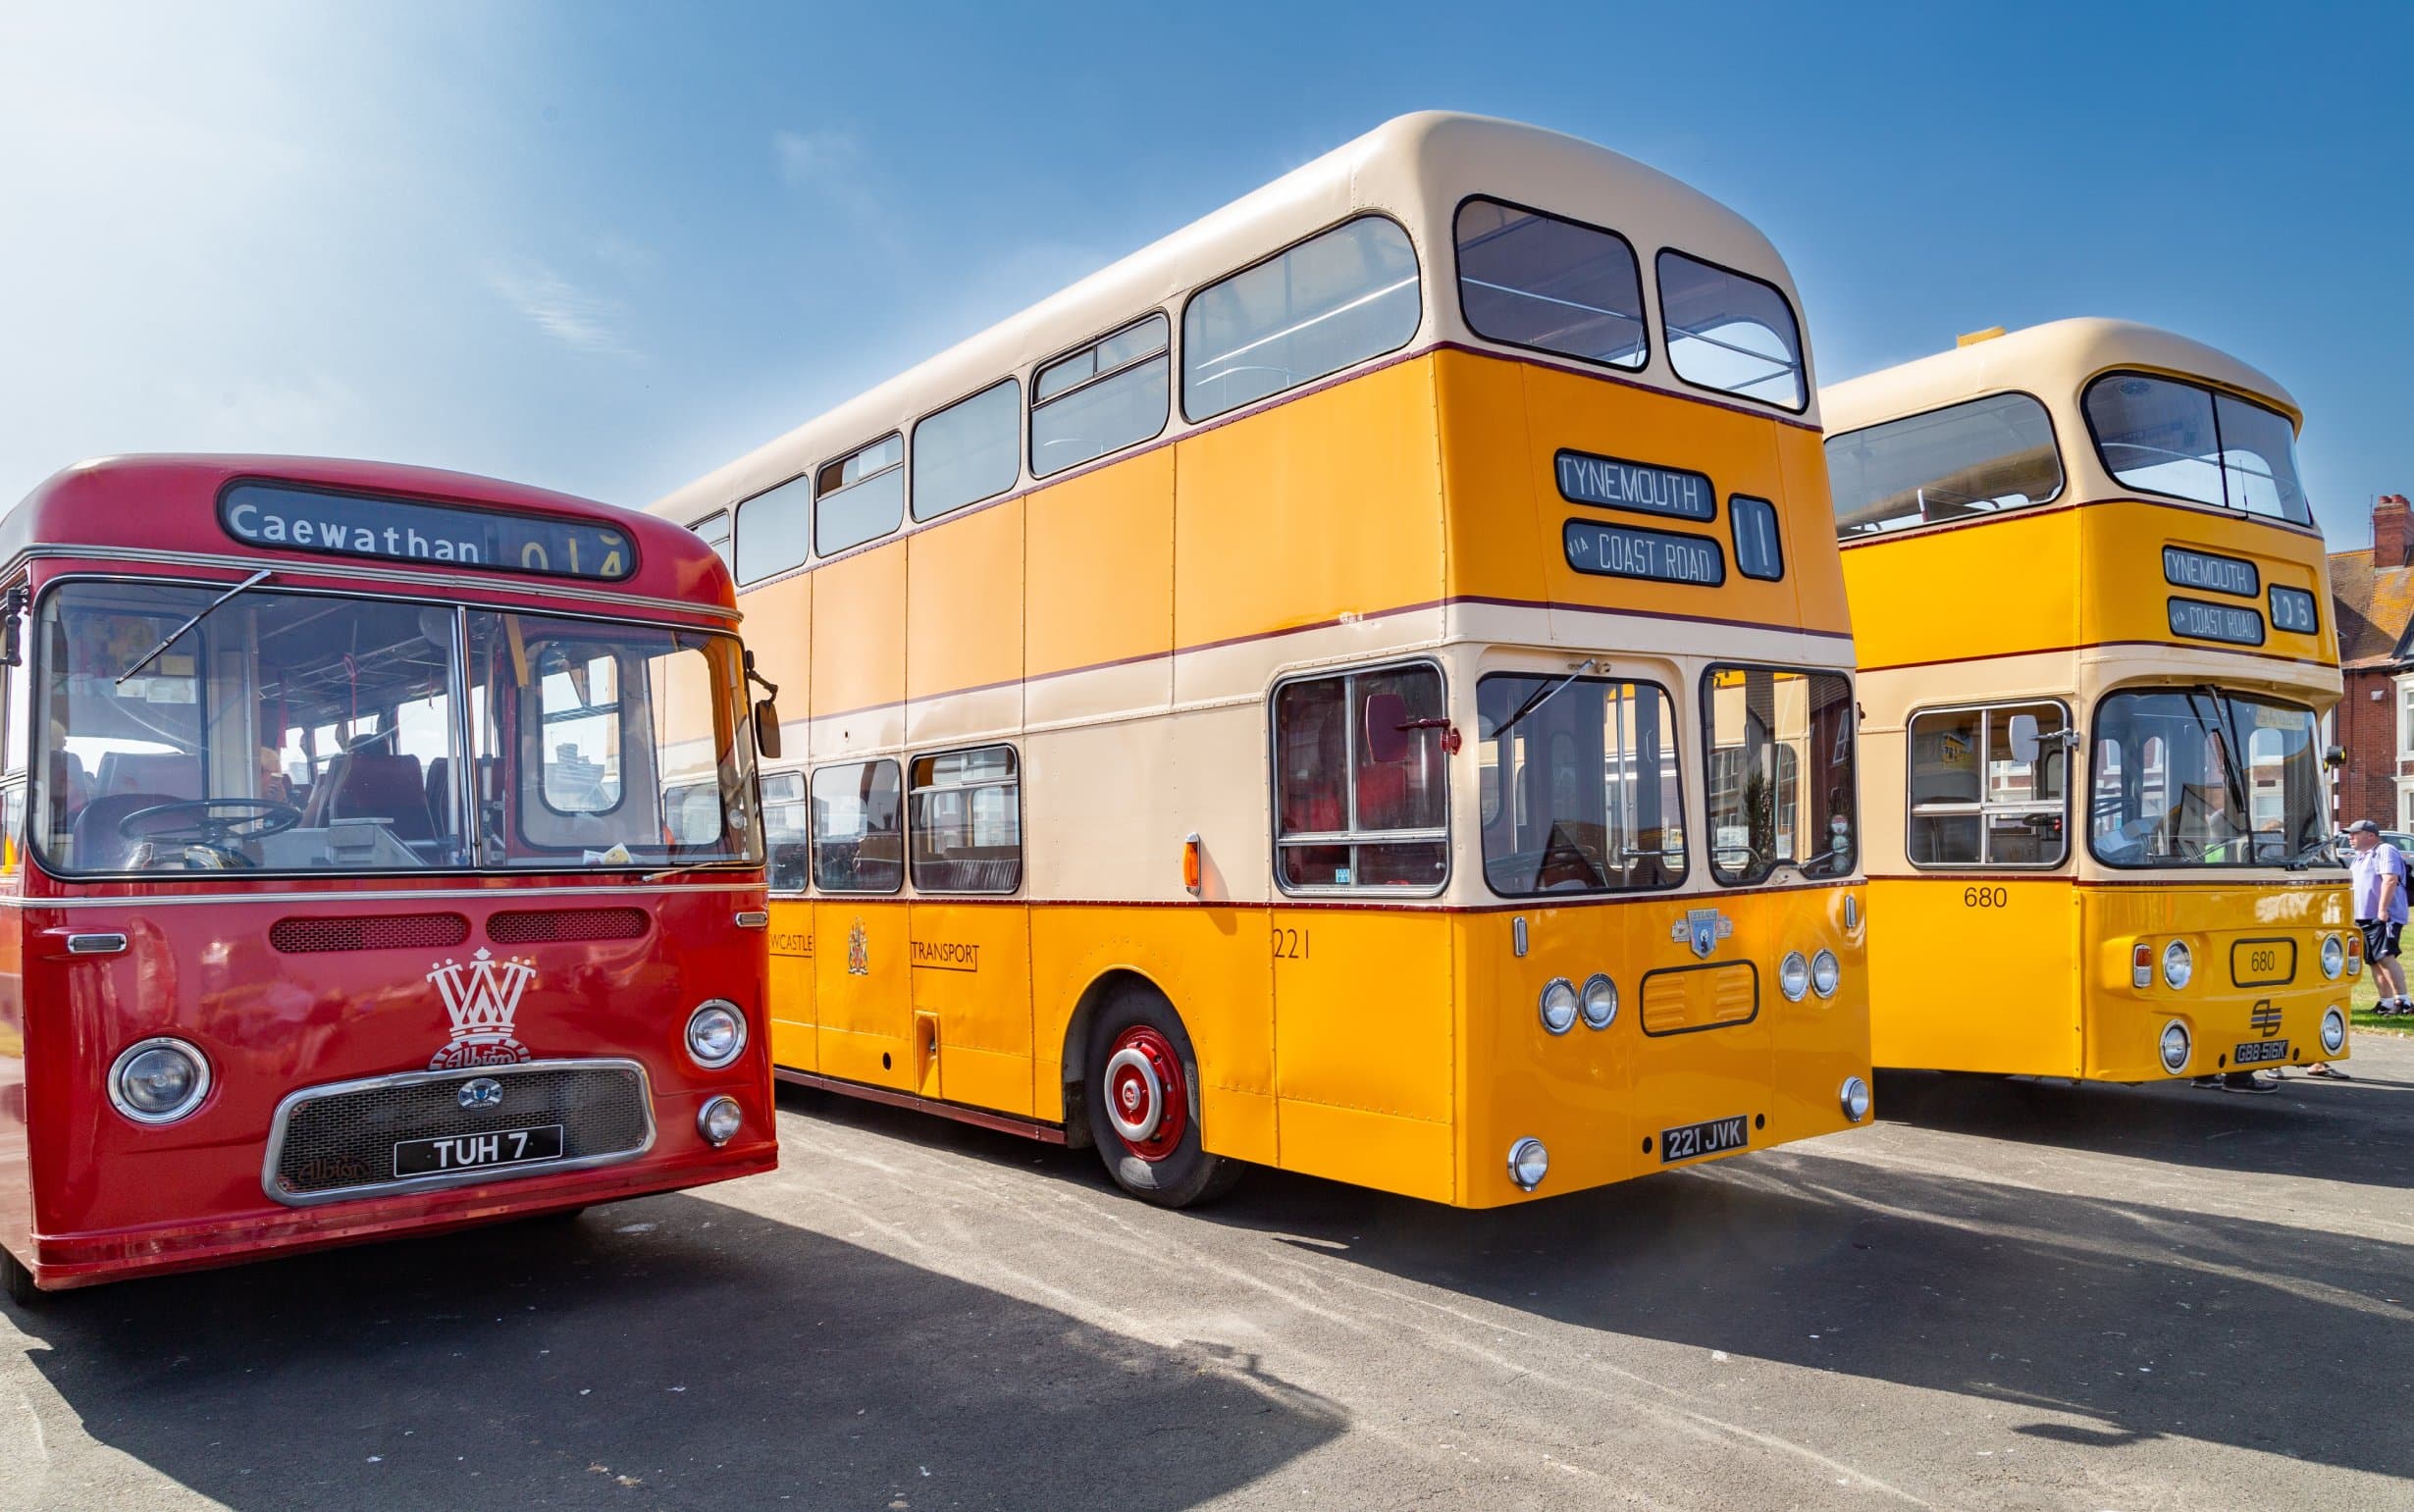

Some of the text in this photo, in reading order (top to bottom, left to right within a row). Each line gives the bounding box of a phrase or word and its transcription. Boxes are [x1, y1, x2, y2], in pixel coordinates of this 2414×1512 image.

[1558, 457, 1699, 511] TYNEMOUTH
[1567, 534, 1710, 582] VIA COAST ROAD
[2164, 551, 2247, 592] TYNEMOUTH
[2189, 606, 2223, 636] COAST
[2228, 611, 2255, 638] ROAD
[1965, 887, 2007, 908] 680
[769, 933, 979, 964] WCASTLE TRANSPORT
[1273, 928, 1309, 959] 221
[2251, 951, 2275, 971] 680
[446, 1045, 517, 1068] Albion
[434, 1132, 528, 1169] TUH 7
[1668, 1120, 1741, 1158] 221 JVK
